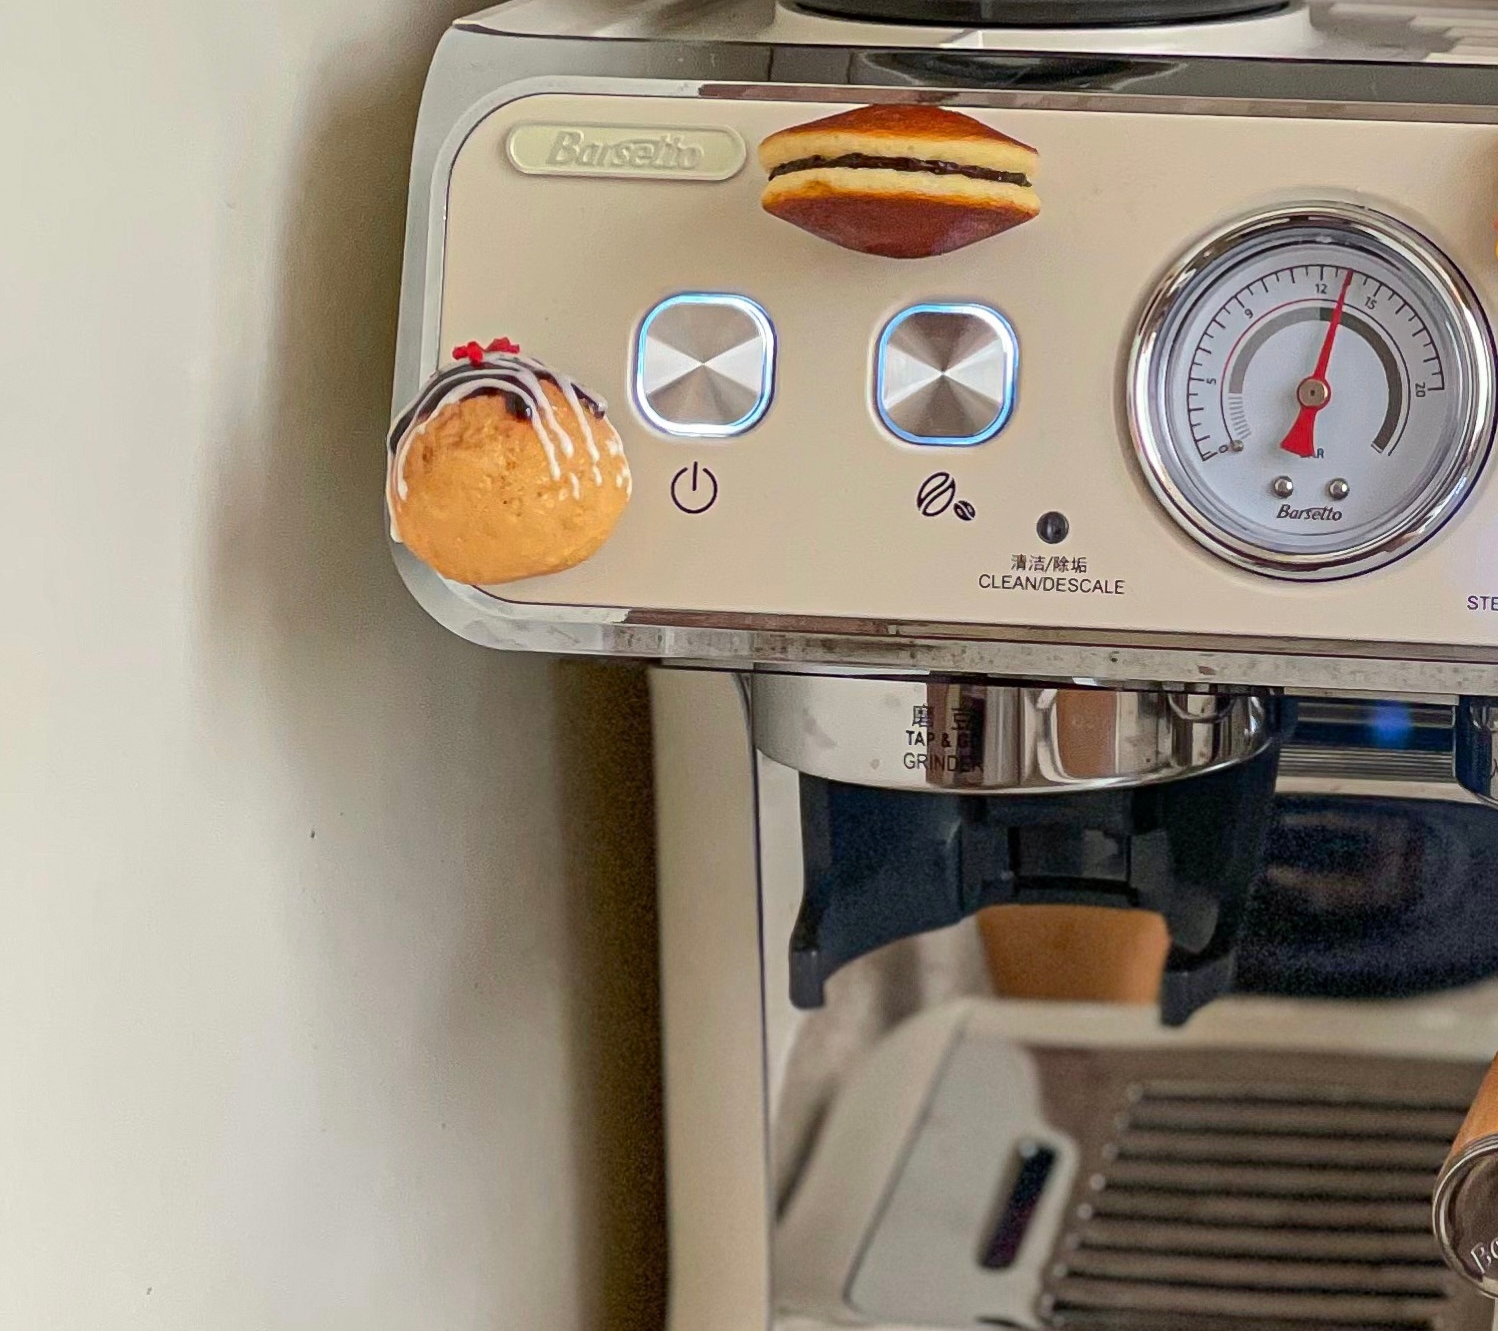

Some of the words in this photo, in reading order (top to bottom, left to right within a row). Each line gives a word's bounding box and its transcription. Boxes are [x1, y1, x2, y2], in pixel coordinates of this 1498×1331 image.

[1315, 283, 1328, 295] 12
[1364, 296, 1377, 311] 15
[1245, 309, 1254, 319] 9
[1206, 377, 1217, 386] 5
[1414, 382, 1426, 398] 20
[1276, 504, 1343, 521] Barsetto
[1011, 554, 1088, 574] 清洁/除垢
[978, 573, 1126, 595] CLEAN/DESCALE
[905, 729, 935, 746] TAP
[941, 732, 952, 748] &
